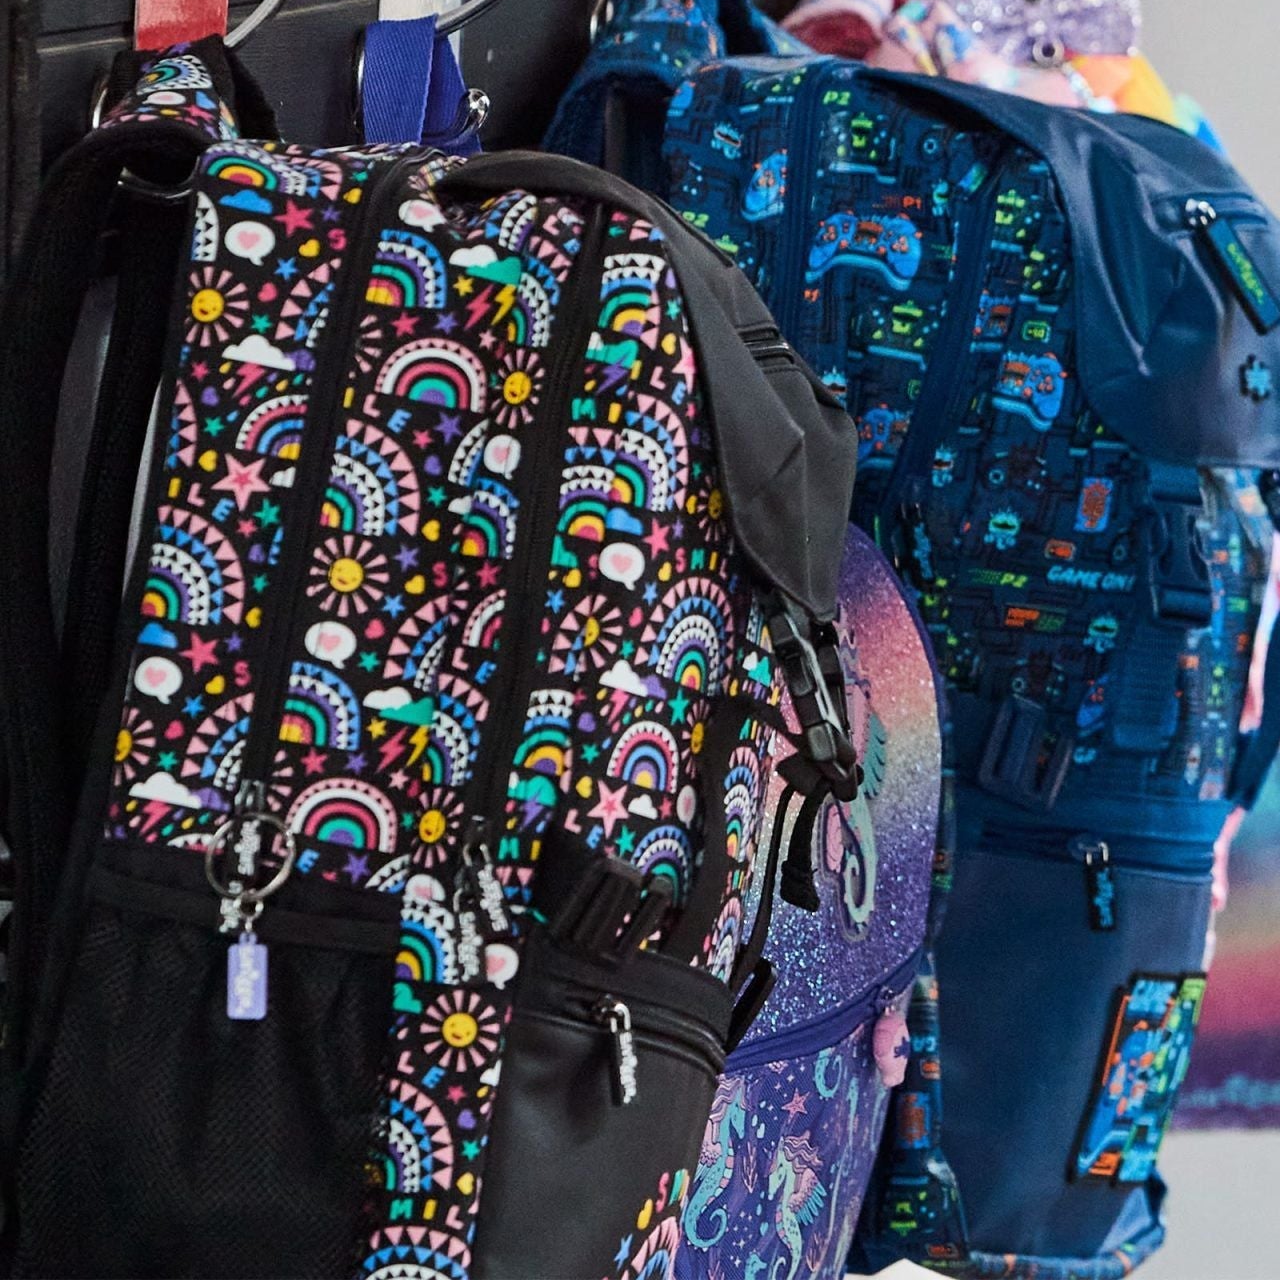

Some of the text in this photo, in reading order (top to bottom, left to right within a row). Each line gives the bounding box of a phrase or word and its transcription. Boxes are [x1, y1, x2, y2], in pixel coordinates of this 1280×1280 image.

[822, 91, 851, 105] P2
[903, 196, 921, 210] P1
[1046, 565, 1101, 589] GAME
